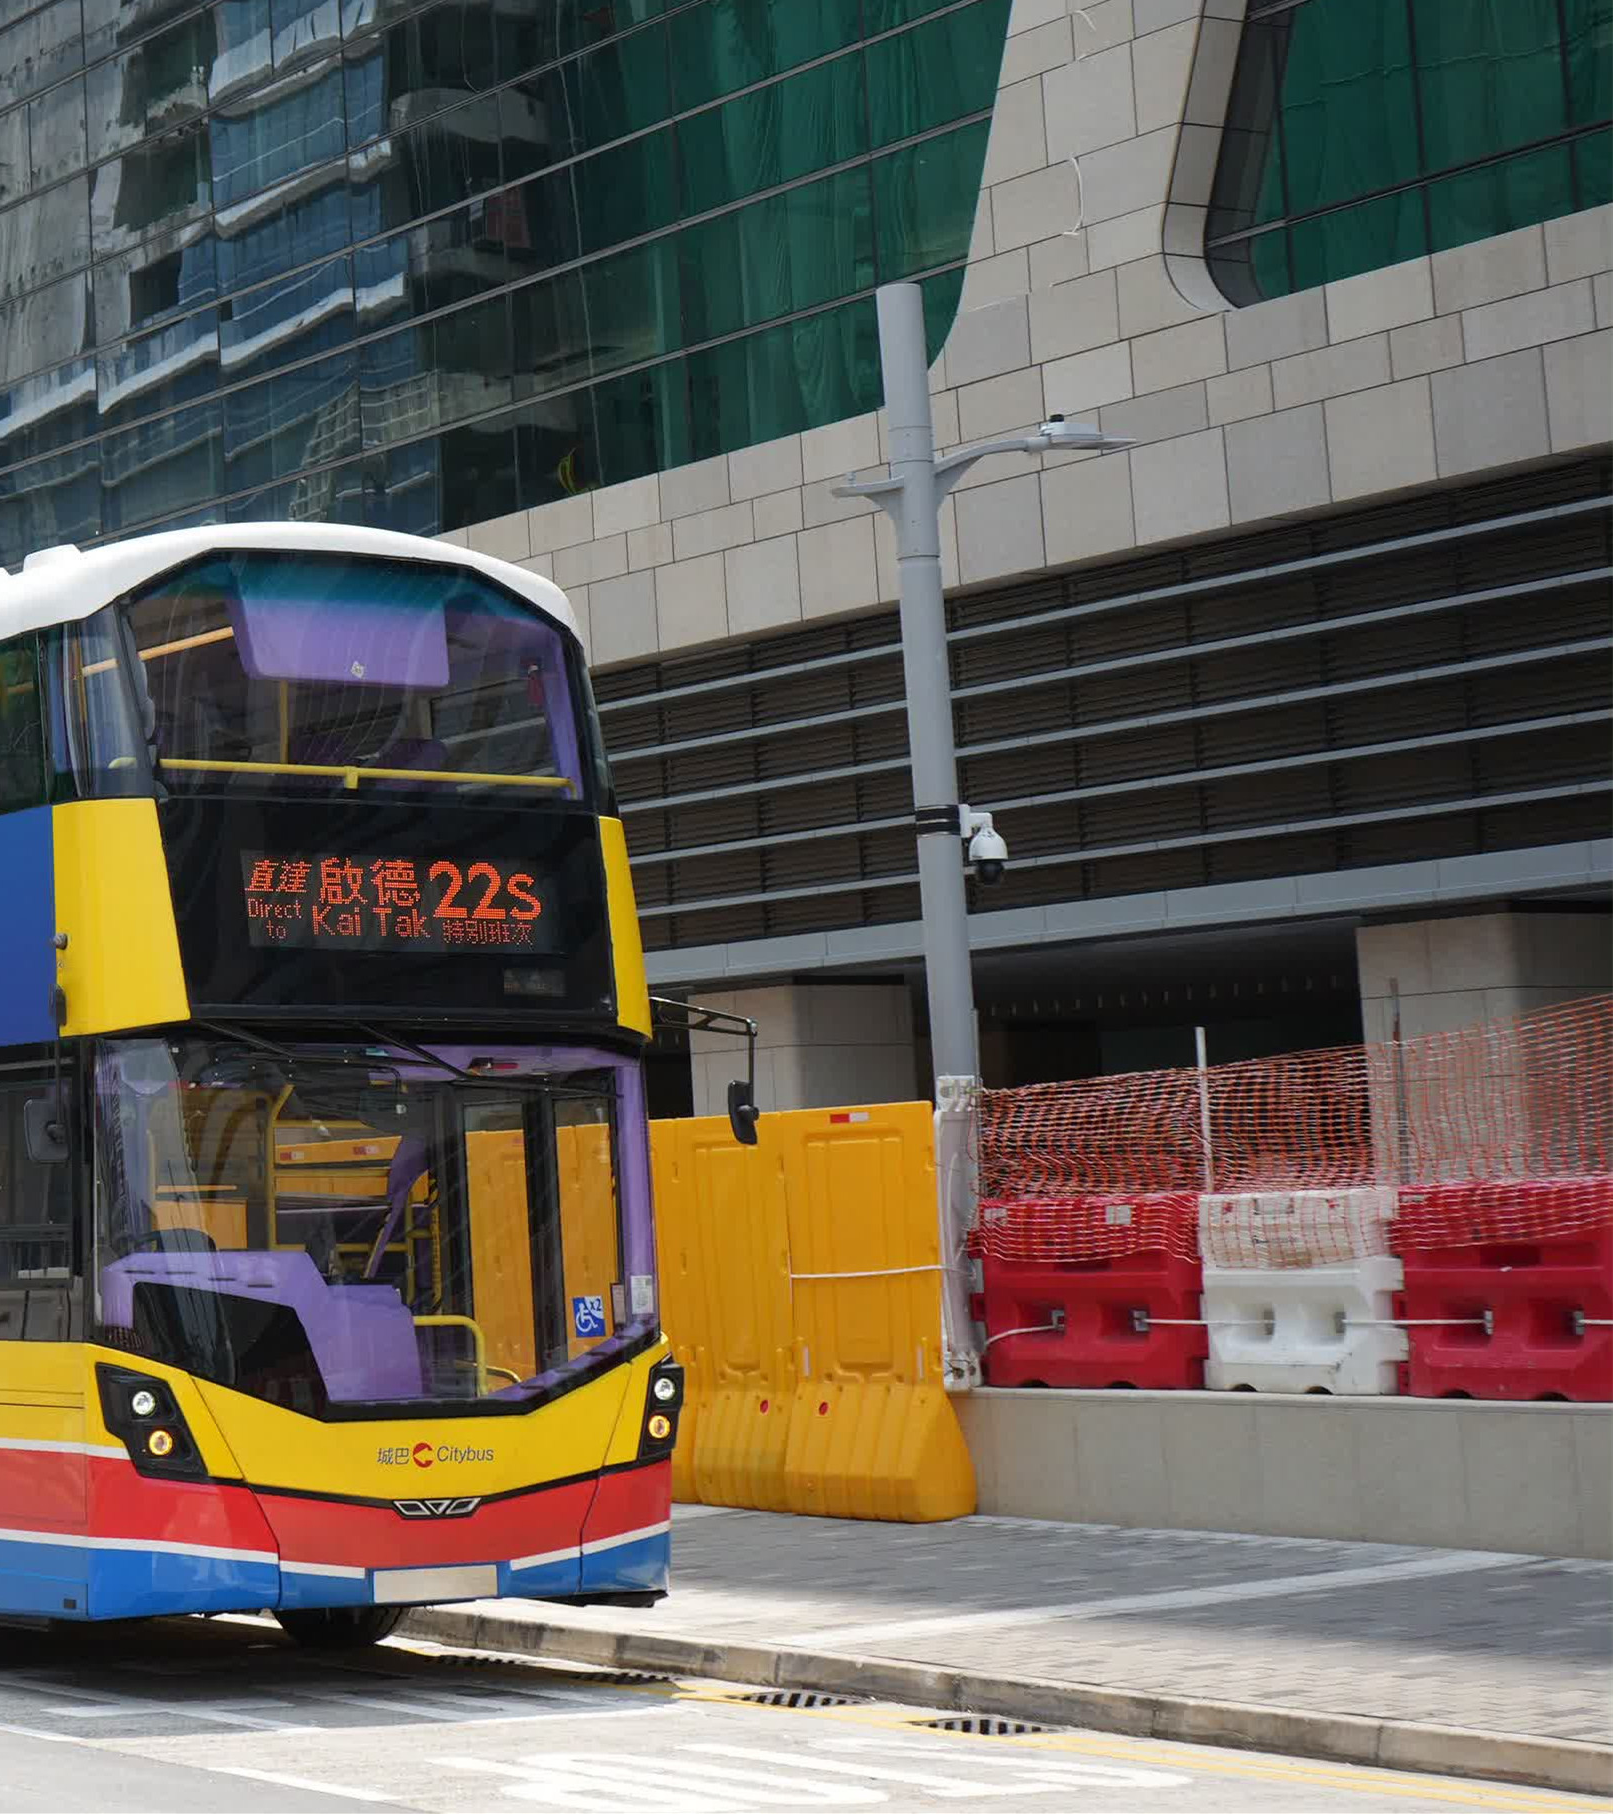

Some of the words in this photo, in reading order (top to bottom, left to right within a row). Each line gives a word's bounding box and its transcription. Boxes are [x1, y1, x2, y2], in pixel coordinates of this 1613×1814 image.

[244, 859, 312, 893] 直達
[429, 860, 542, 920] 22S
[247, 898, 303, 920] Direct
[312, 904, 361, 937] Kai
[372, 906, 431, 938] Tak
[266, 919, 287, 940] to
[441, 920, 534, 947] 特別班次
[377, 1447, 409, 1465] 城巴
[437, 1445, 494, 1464] Citybus
